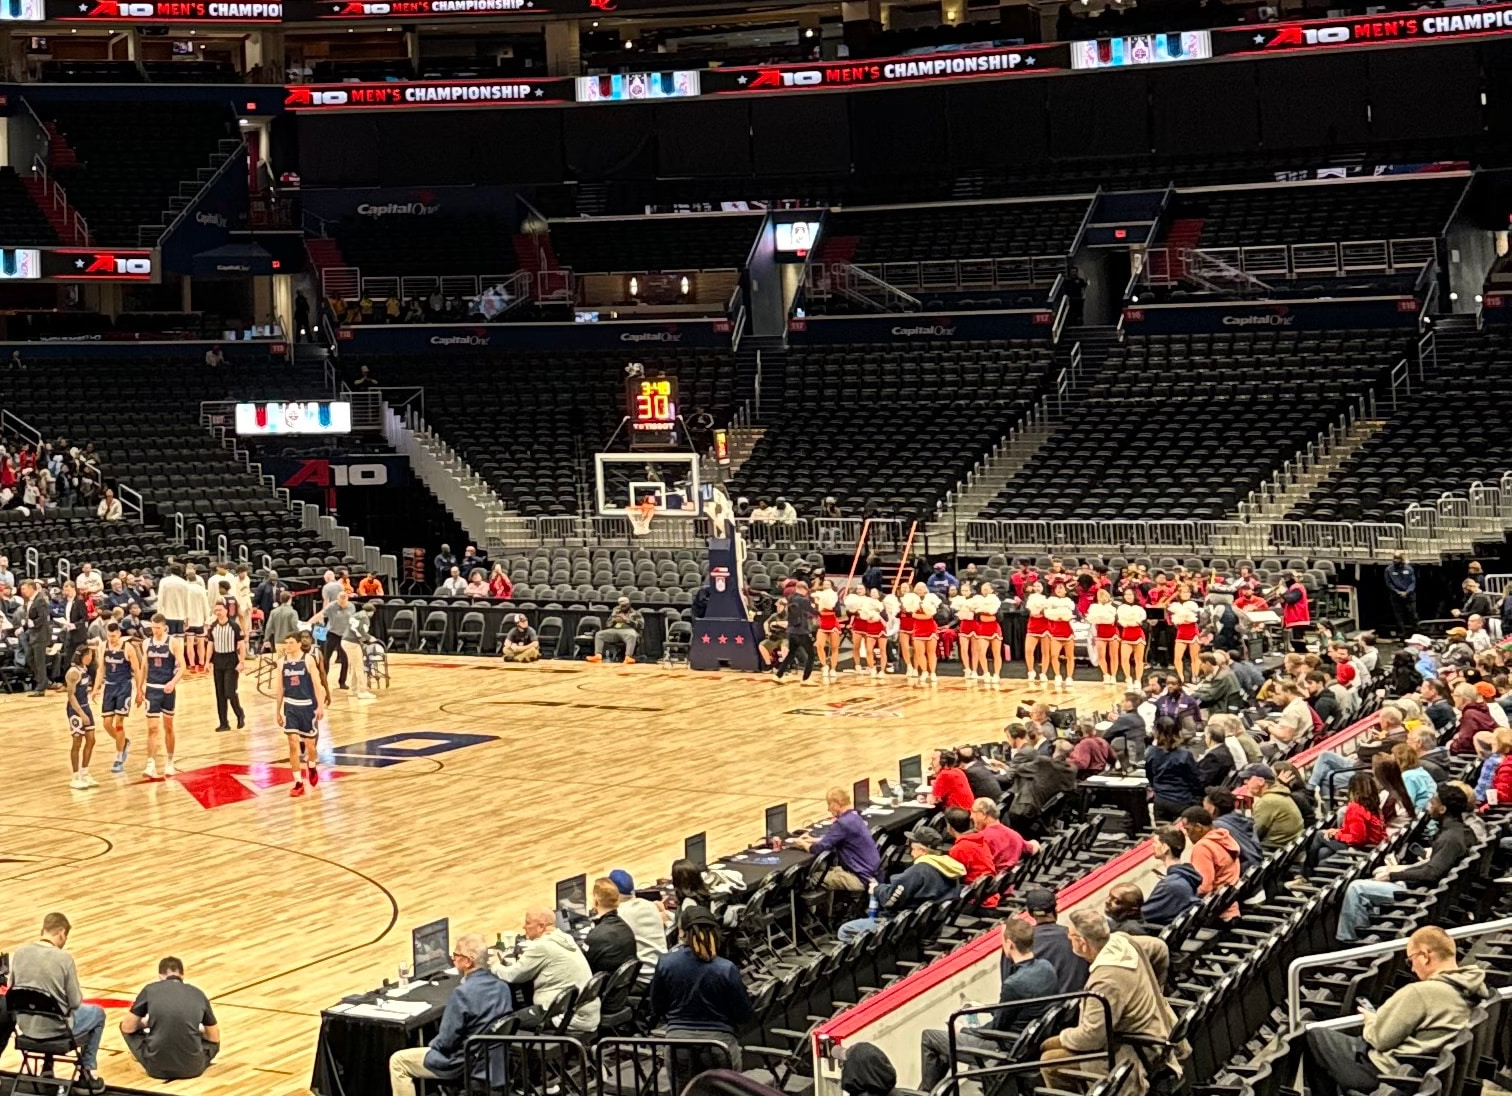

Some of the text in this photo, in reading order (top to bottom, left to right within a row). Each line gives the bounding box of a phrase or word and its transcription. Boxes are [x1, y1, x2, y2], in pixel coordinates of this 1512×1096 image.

[748, 55, 1021, 89] A10 MEN'S CHAMPIONSHIP
[286, 84, 531, 105] A10 MEN'S CHAMPIONSHIP
[285, 458, 387, 488] A10
